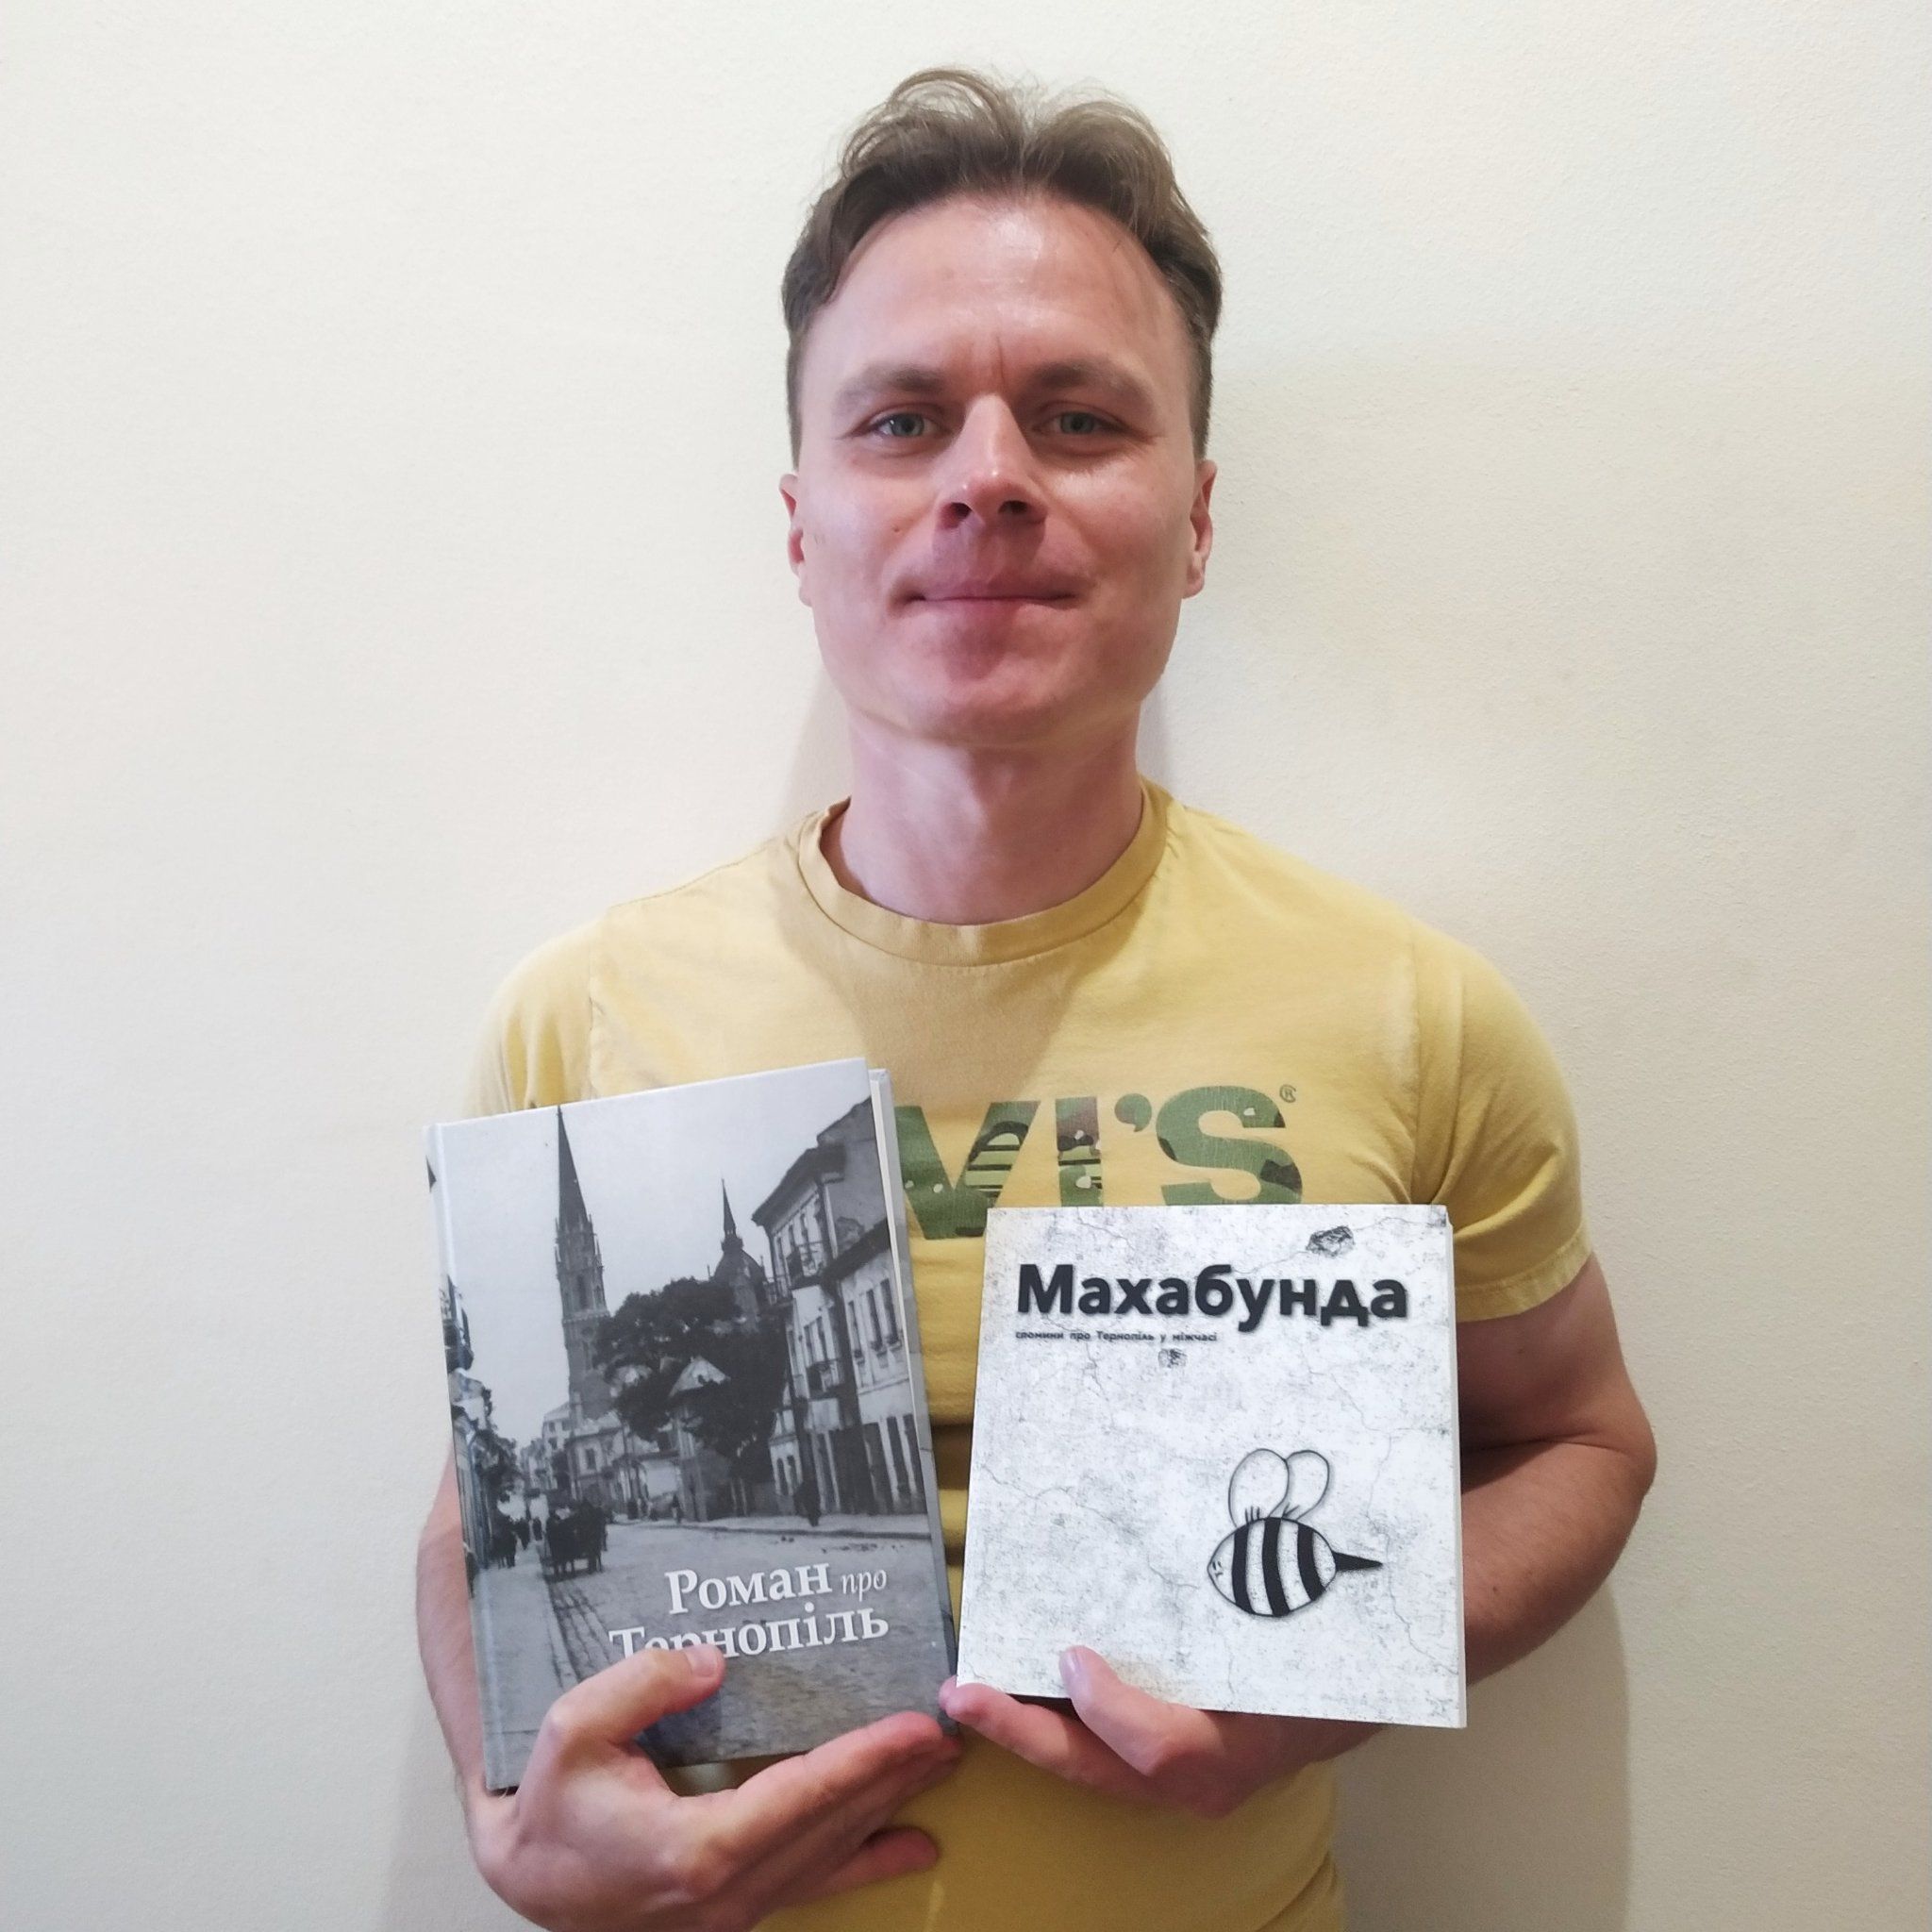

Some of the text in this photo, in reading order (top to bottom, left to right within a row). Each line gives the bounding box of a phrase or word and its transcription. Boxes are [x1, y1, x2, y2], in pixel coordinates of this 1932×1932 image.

[1016, 1263, 1409, 1333] Махабунда
[1015, 1331, 1064, 1341] спомини
[1070, 1331, 1091, 1343] про
[1096, 1330, 1155, 1342] Тернопіль
[1159, 1332, 1167, 1343] у
[664, 1562, 888, 1615] Роман про
[608, 1602, 889, 1660] Тнопіль
